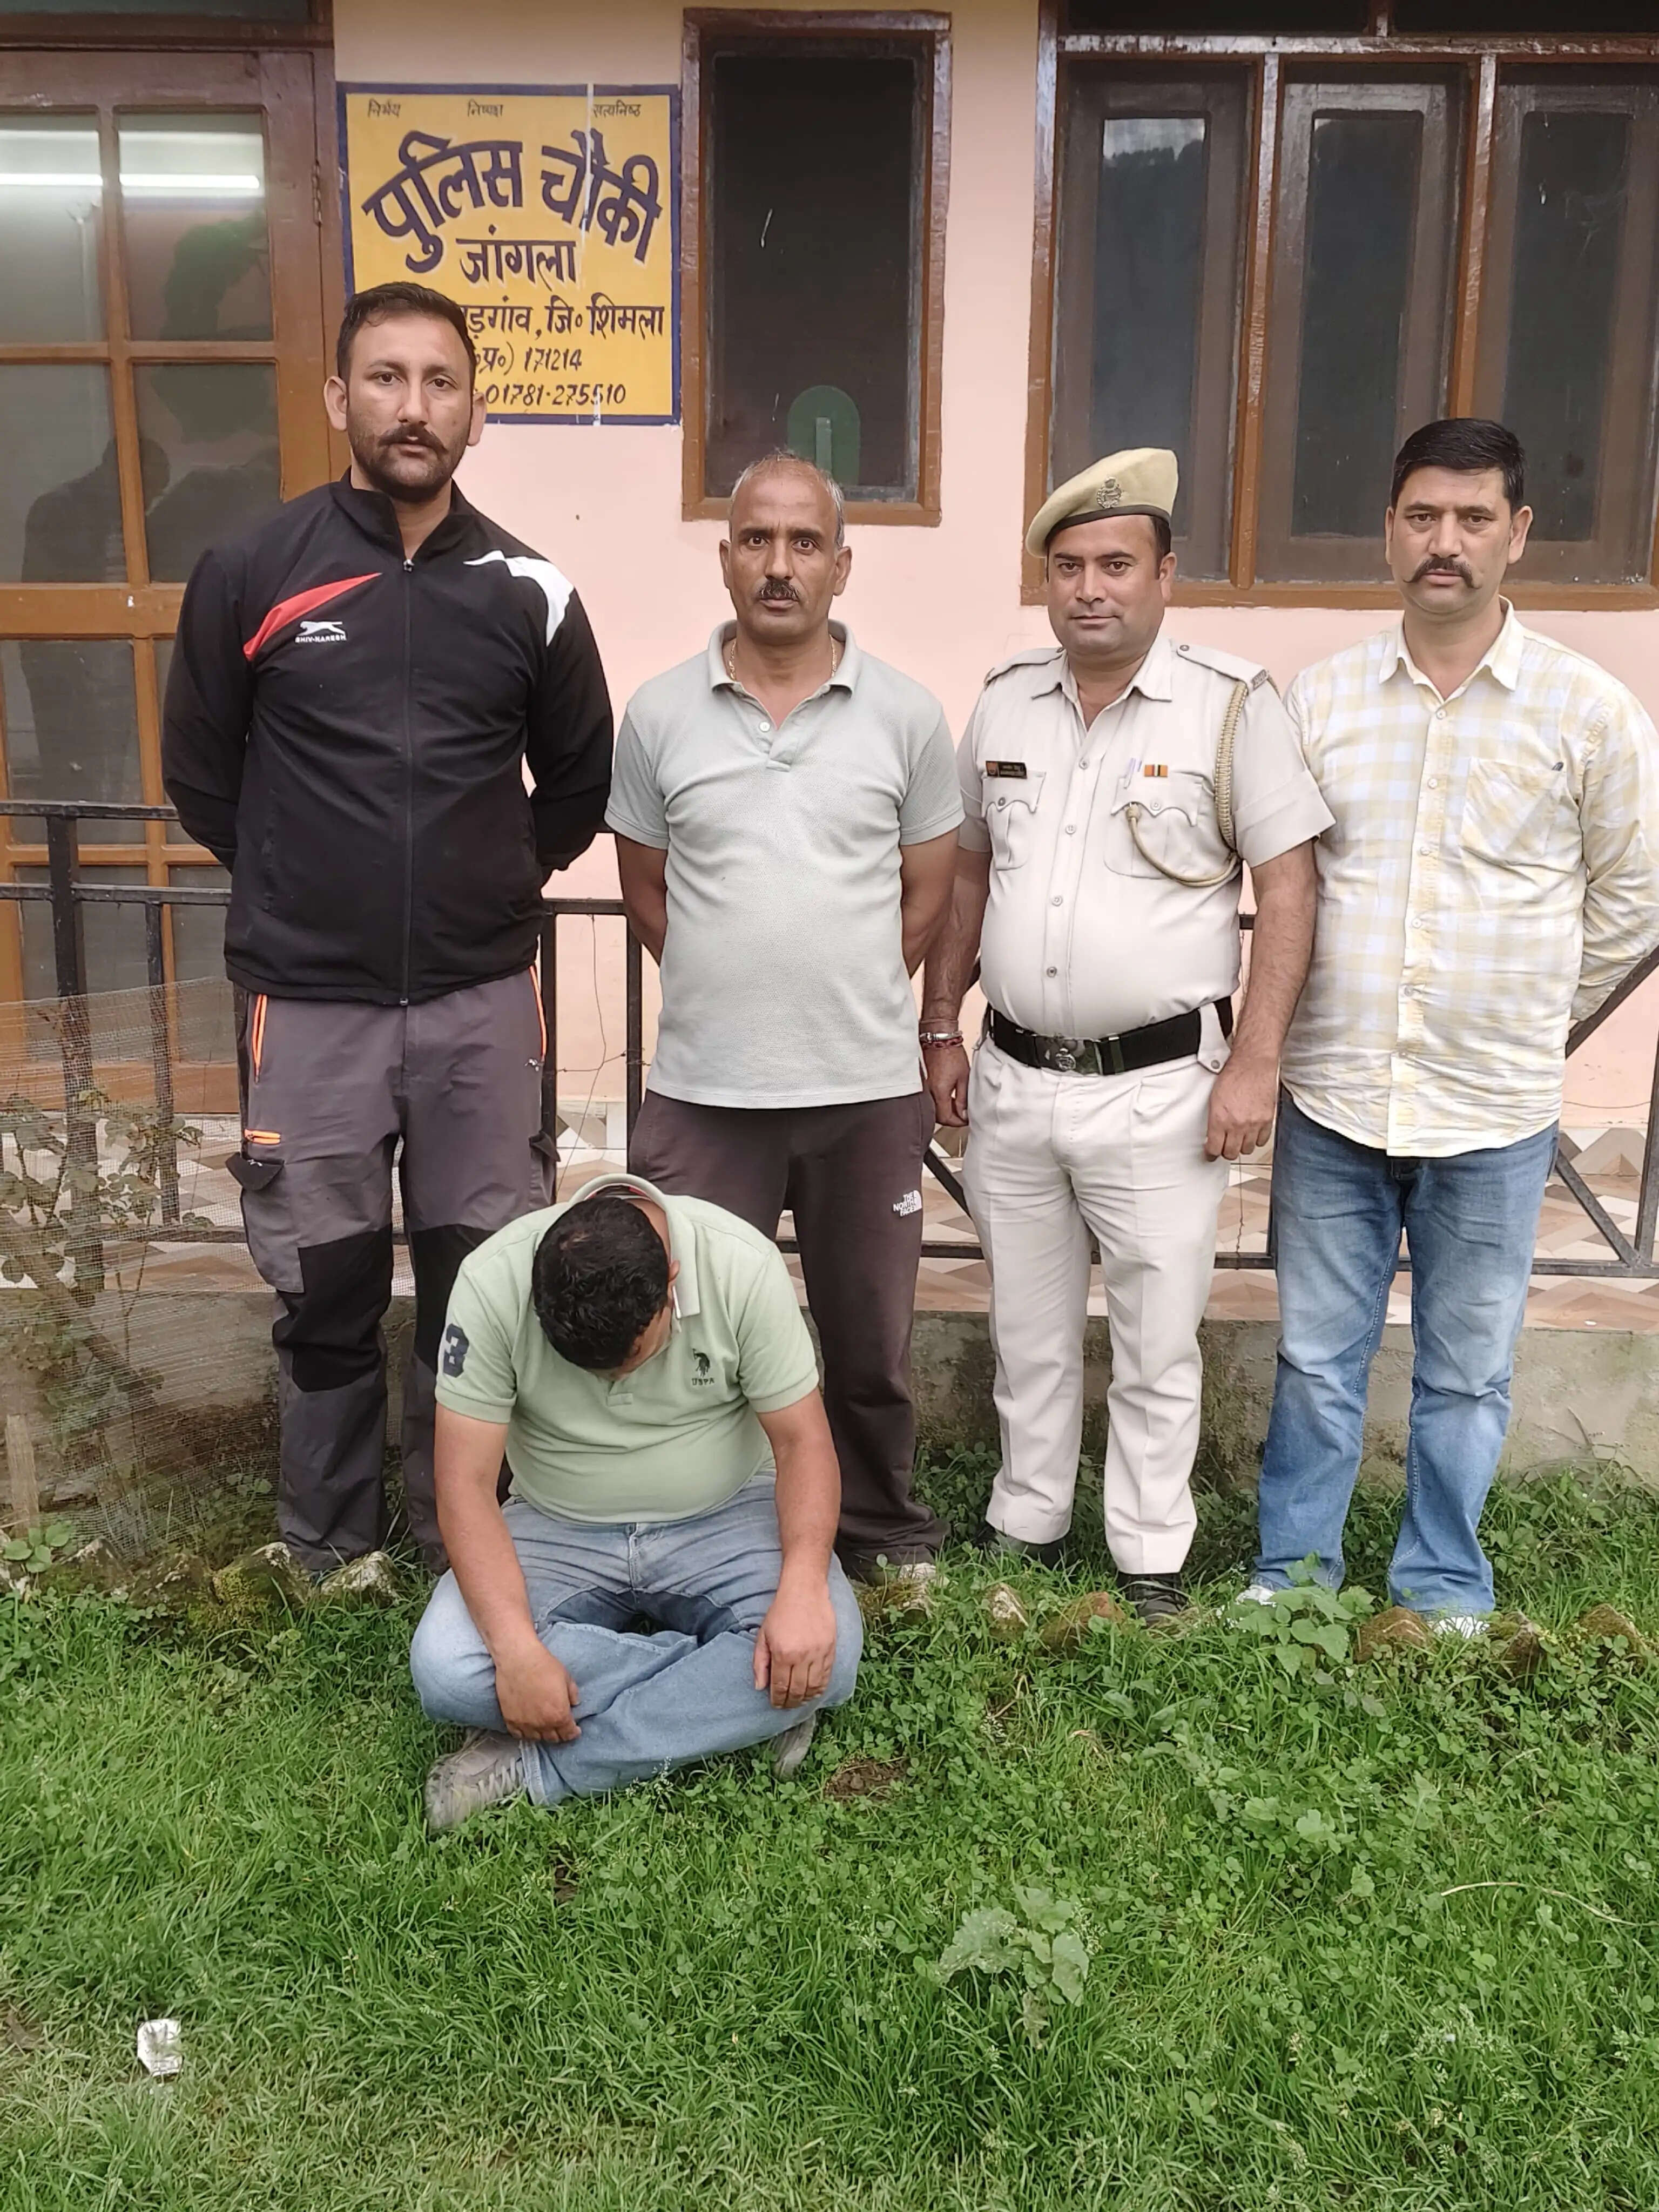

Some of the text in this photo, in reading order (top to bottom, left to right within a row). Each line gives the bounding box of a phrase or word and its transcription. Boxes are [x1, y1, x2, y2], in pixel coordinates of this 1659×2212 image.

[593, 99, 642, 118] सत्यनिष्ठ
[362, 128, 664, 274] पुलिस चौकी
[456, 224, 576, 292] जांगला
[460, 295, 542, 340] ड़गांव,
[586, 292, 665, 340] शिमला
[524, 346, 582, 373] 171214
[893, 1197, 914, 1212] NORTH
[443, 1324, 469, 1378] 3
[691, 1377, 714, 1386] USPA
